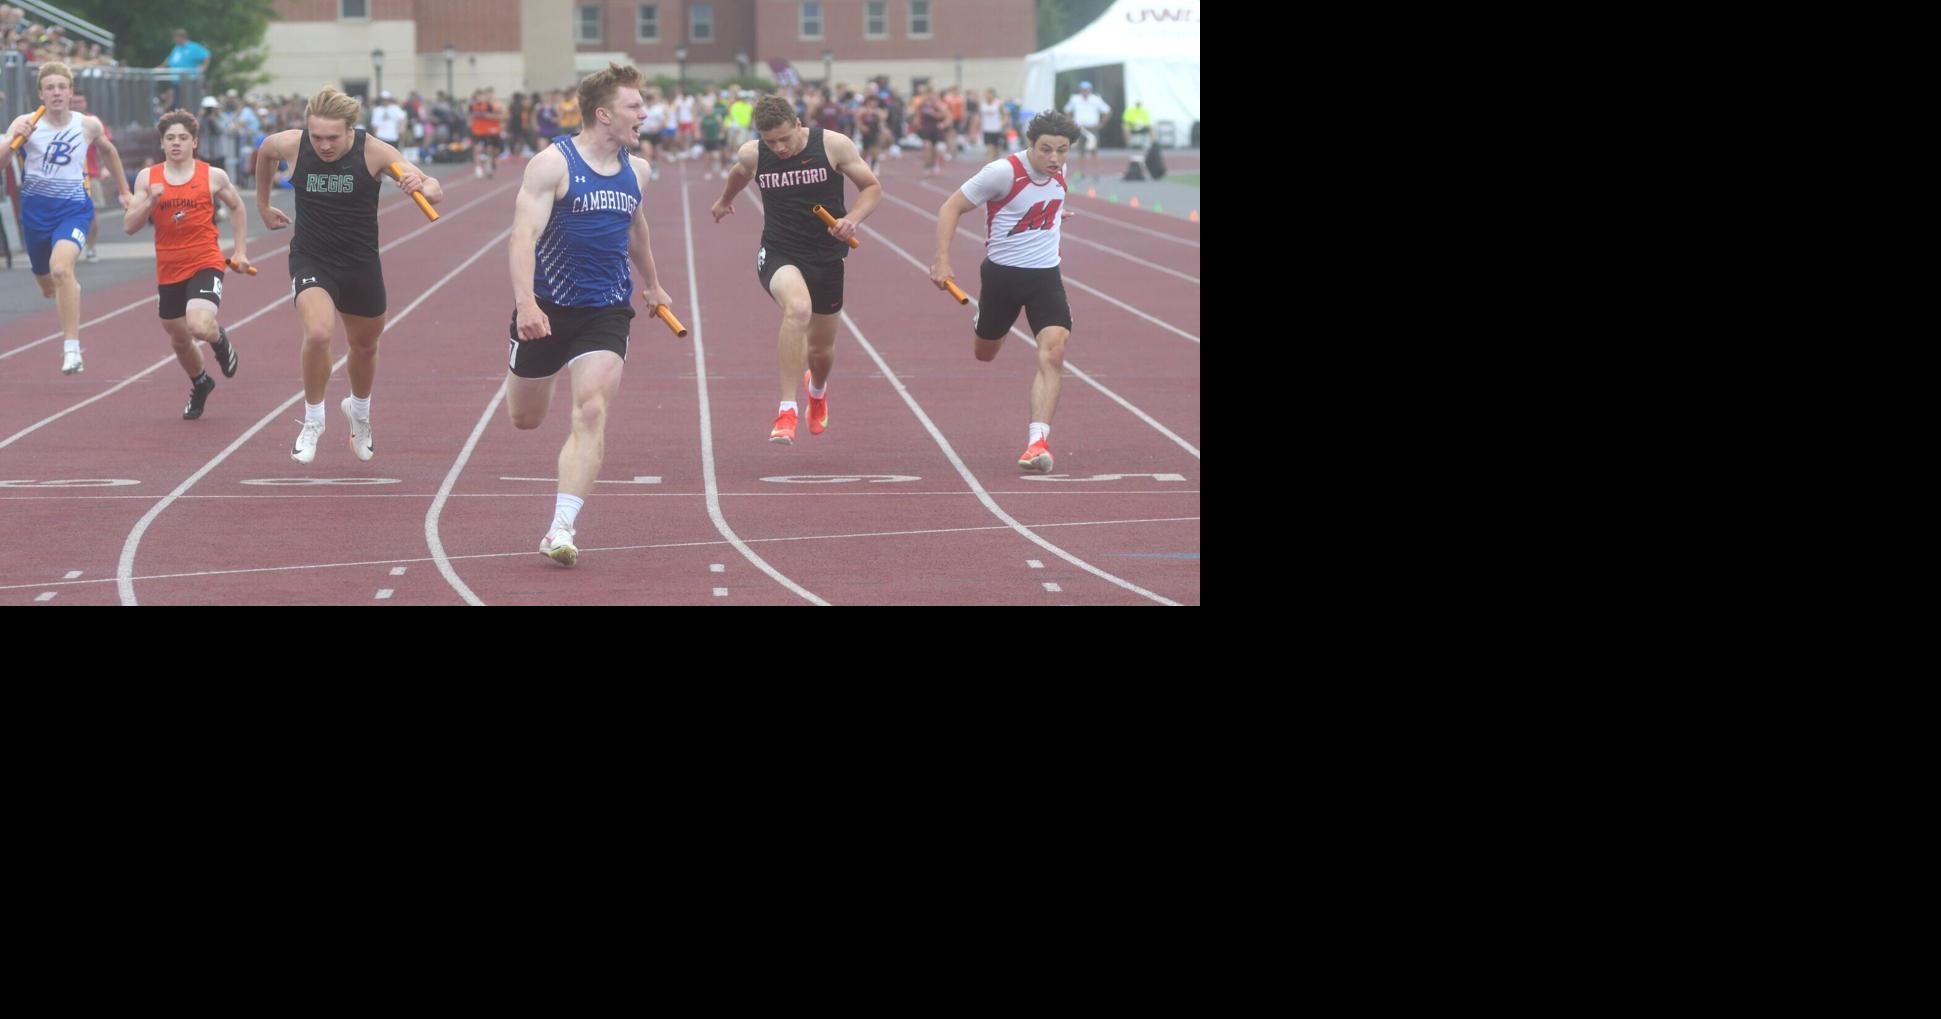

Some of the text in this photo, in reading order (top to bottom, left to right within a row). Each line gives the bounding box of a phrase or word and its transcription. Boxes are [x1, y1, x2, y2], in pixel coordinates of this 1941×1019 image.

[306, 173, 353, 192] REGIS
[759, 167, 827, 188] STRATFORD
[1006, 199, 1062, 237] M
[240, 477, 401, 485] 8
